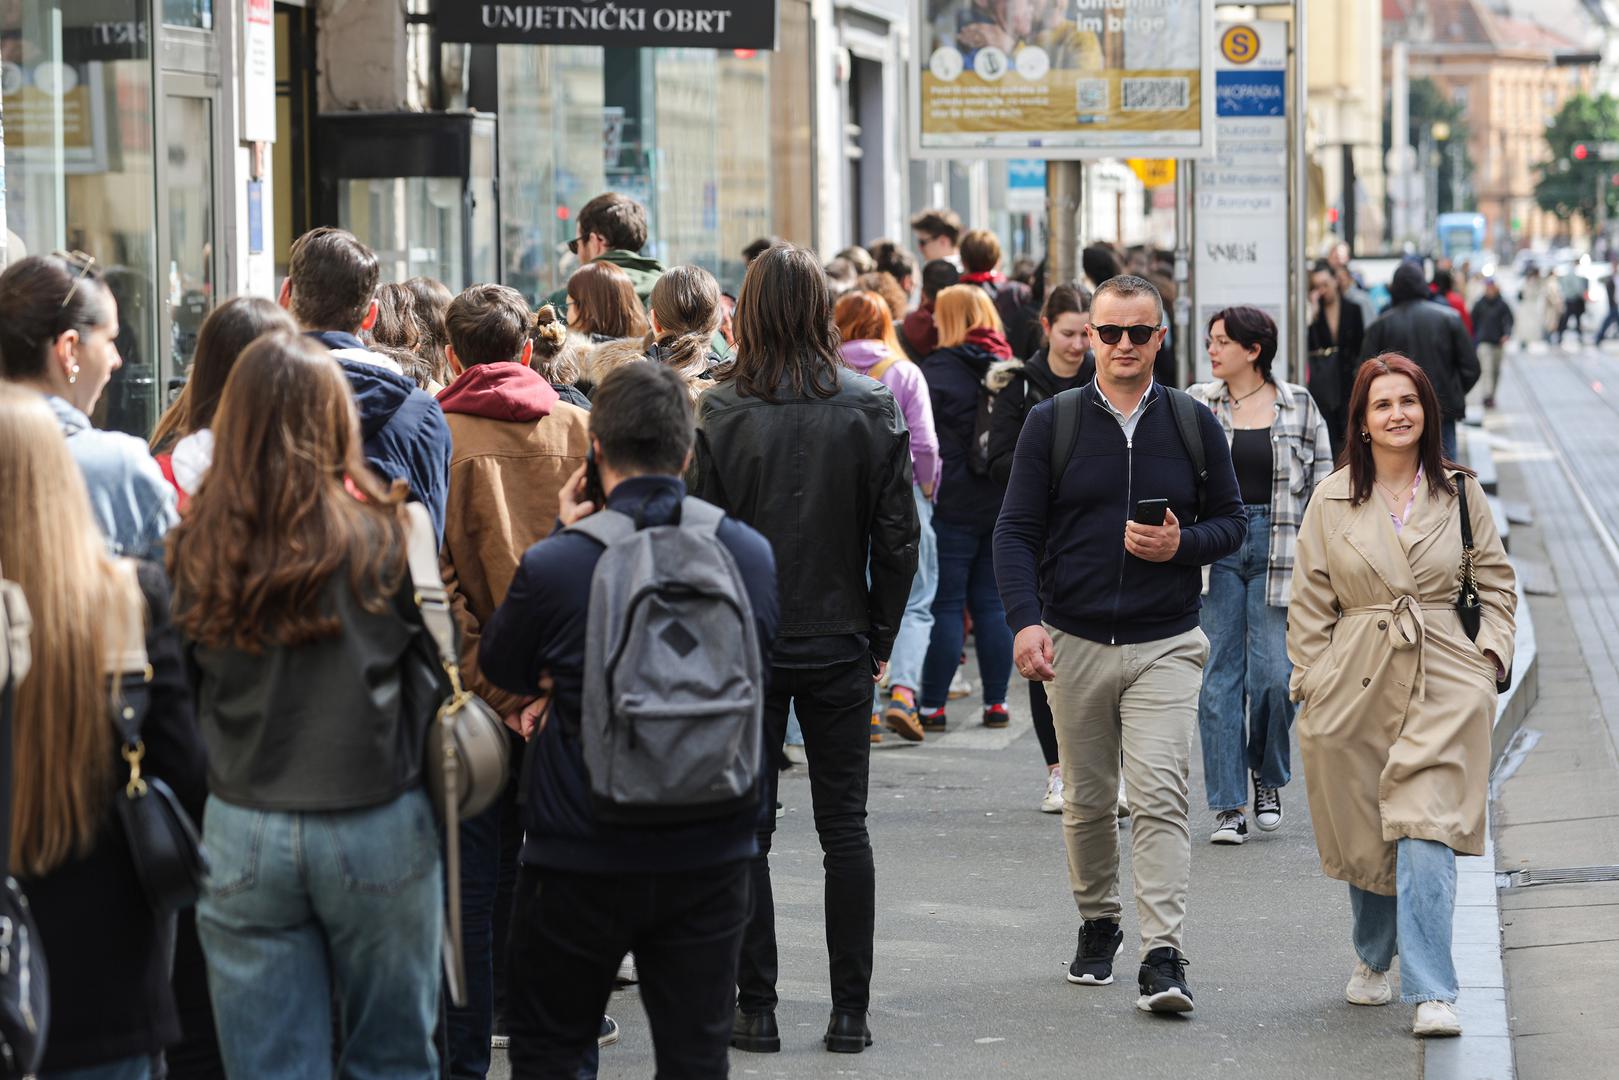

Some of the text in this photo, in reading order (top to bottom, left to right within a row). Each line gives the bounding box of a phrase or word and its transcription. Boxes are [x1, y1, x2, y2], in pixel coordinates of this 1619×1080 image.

[481, 2, 732, 33] UMJETNIČKI OBRT
[1076, 12, 1103, 33] im
[1231, 33, 1249, 57] S
[1216, 84, 1282, 99] NKOPANSKA
